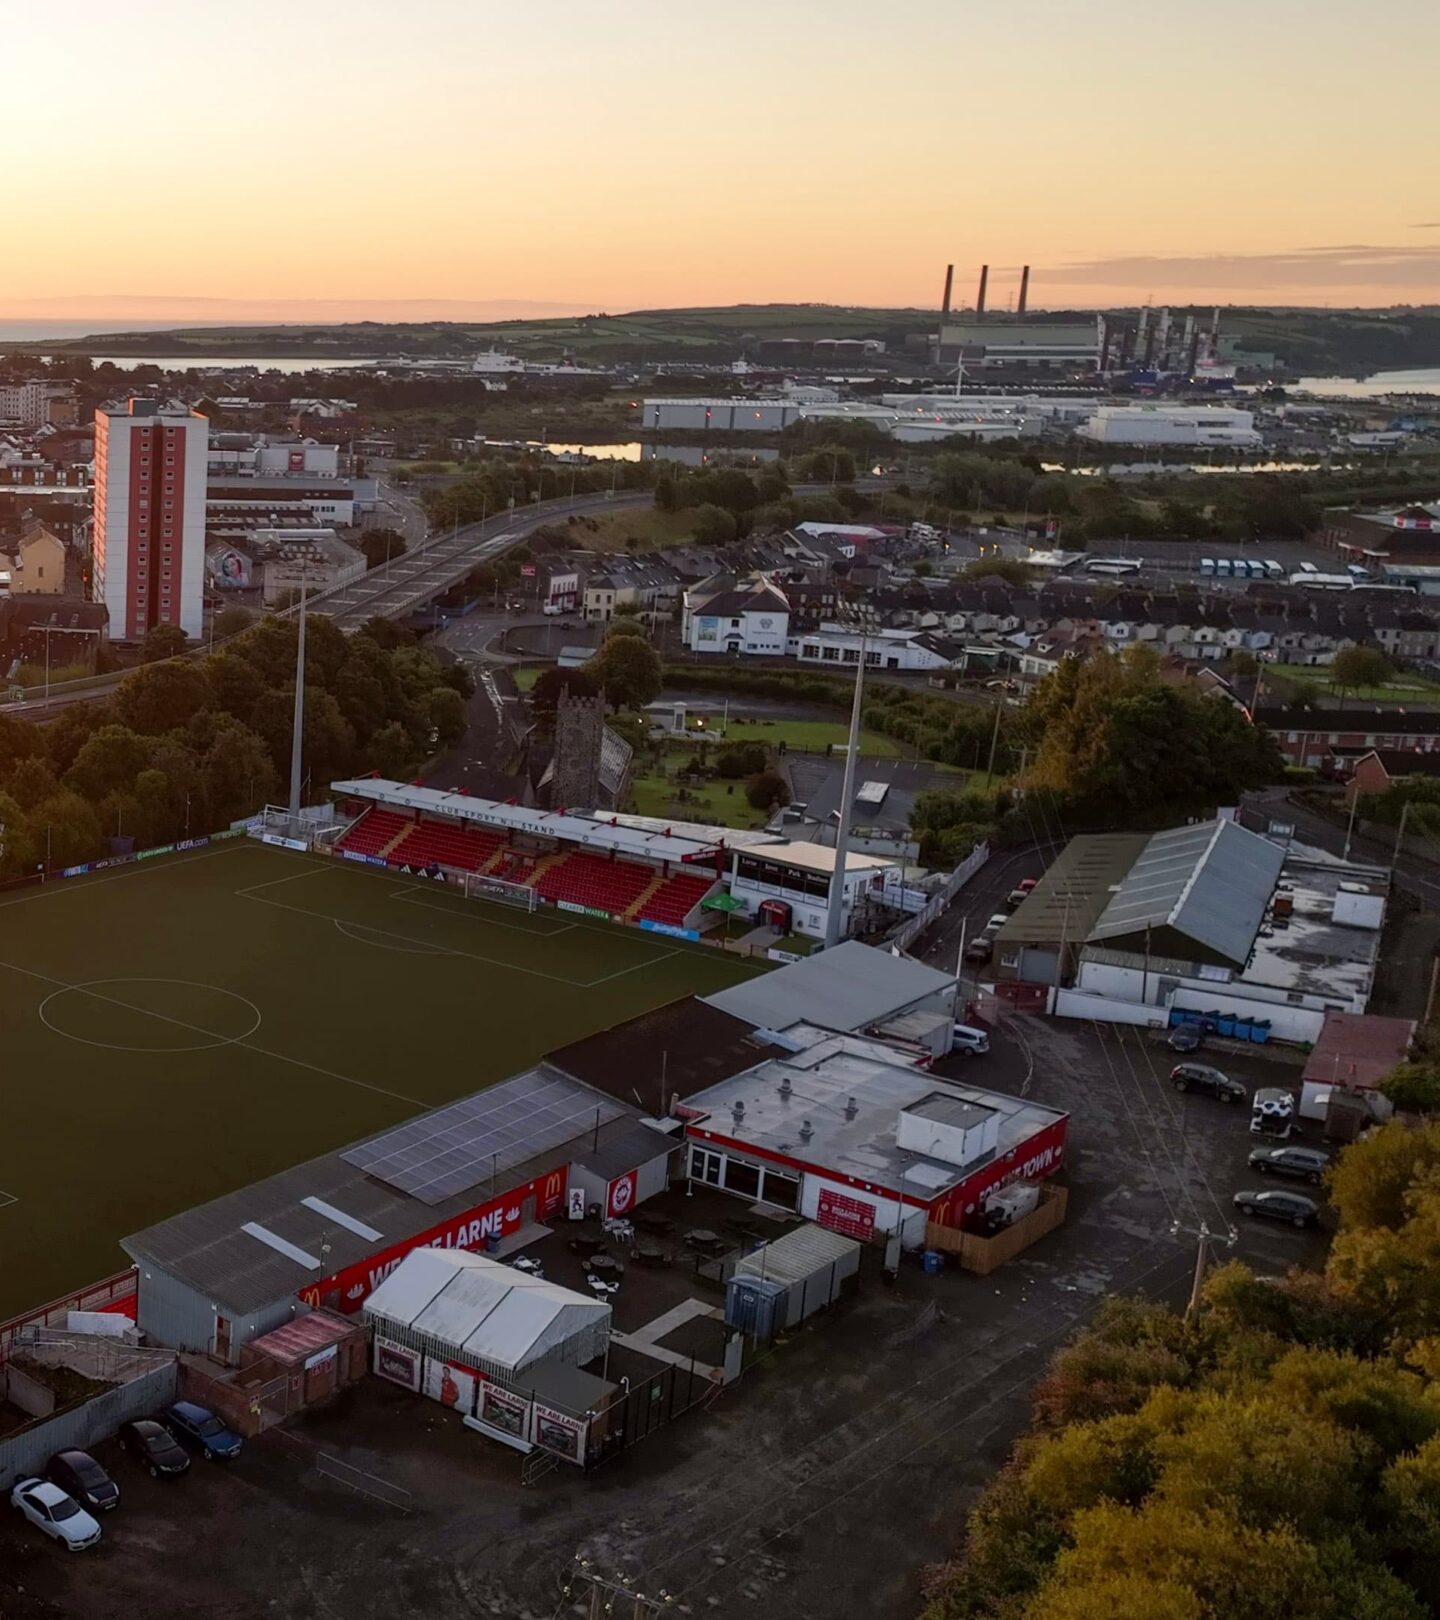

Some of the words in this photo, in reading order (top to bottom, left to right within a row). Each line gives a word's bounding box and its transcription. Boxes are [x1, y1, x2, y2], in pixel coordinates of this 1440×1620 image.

[435, 804, 459, 815] CLUB
[465, 810, 496, 823] SPORT
[522, 822, 556, 835] STAND
[176, 837, 209, 851] UEFA.com
[1023, 1145, 1054, 1178] TOWN
[446, 1207, 504, 1249] LARNE
[493, 1386, 507, 1398] ARE
[508, 1393, 529, 1409] LARNE
[547, 1408, 561, 1421] ARE
[561, 1415, 585, 1433] LARNE
